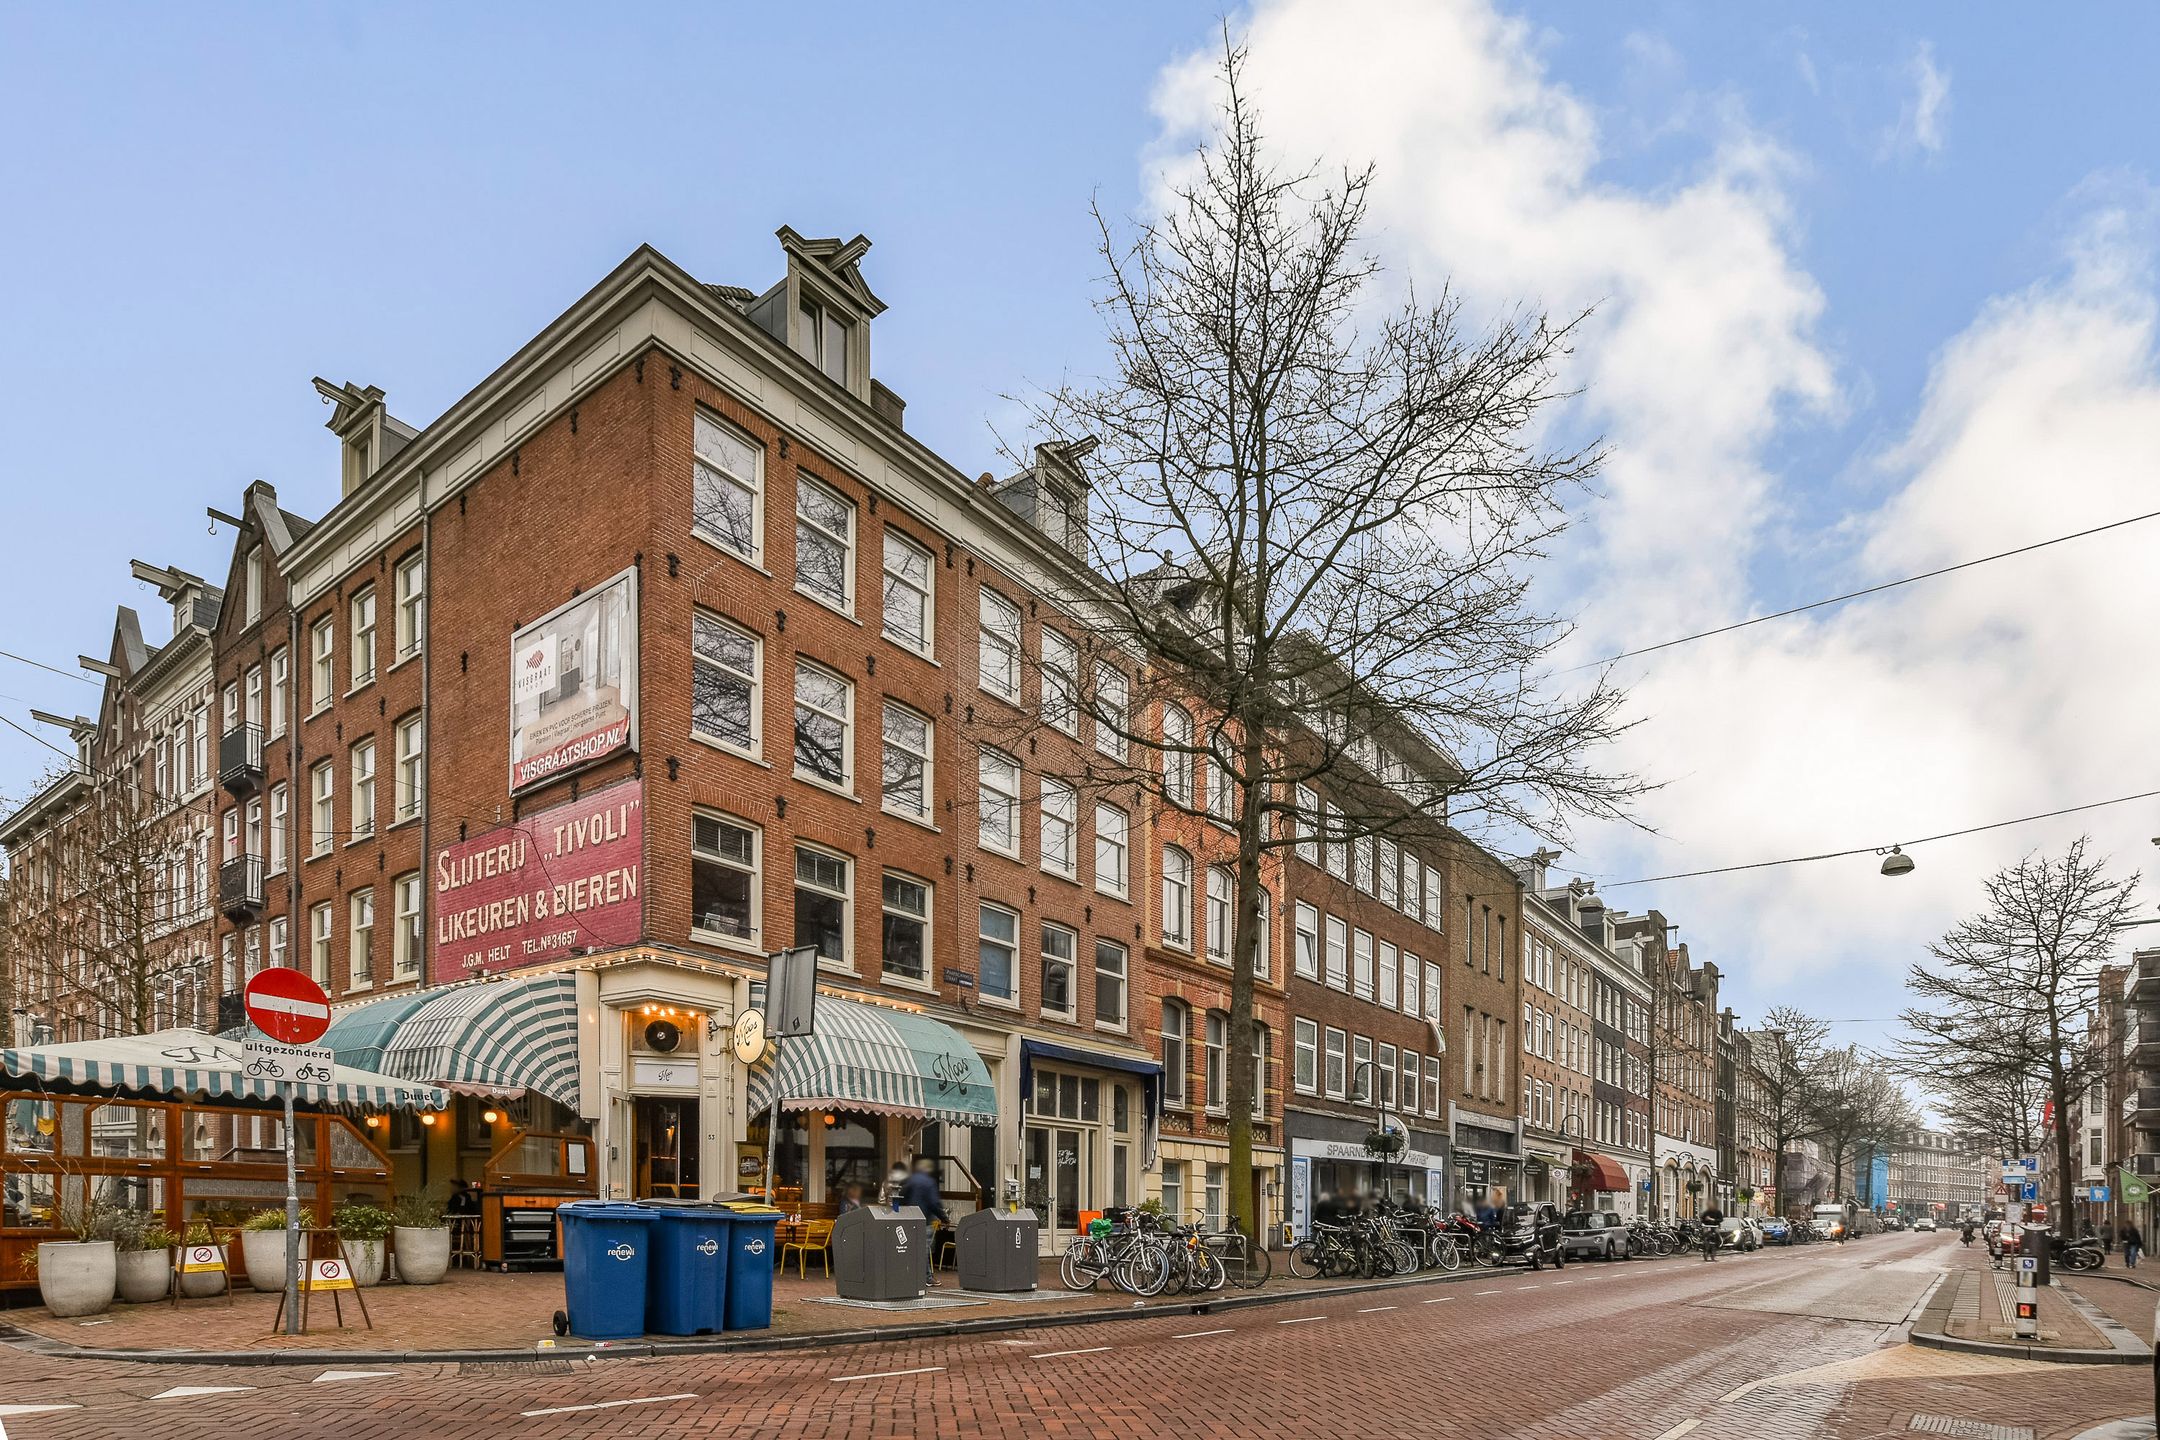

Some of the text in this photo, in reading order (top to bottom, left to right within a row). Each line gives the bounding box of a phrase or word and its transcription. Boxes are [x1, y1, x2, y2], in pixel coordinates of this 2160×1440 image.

[520, 727, 621, 780] VISGRAATSHOP.NL
[437, 838, 526, 892] SLIJTERIJ
[438, 865, 638, 944] LIKEUREN & BIEREN
[461, 952, 485, 968] J.G.M.
[488, 945, 511, 962] HELT
[245, 1042, 332, 1060] uitgezonderd
[931, 1051, 969, 1097] Moos
[402, 1090, 435, 1101] Duvel
[2024, 1182, 2034, 1192] P
[607, 1246, 635, 1257] renewi
[696, 1243, 719, 1252] renewi
[744, 1243, 766, 1252] renewi
